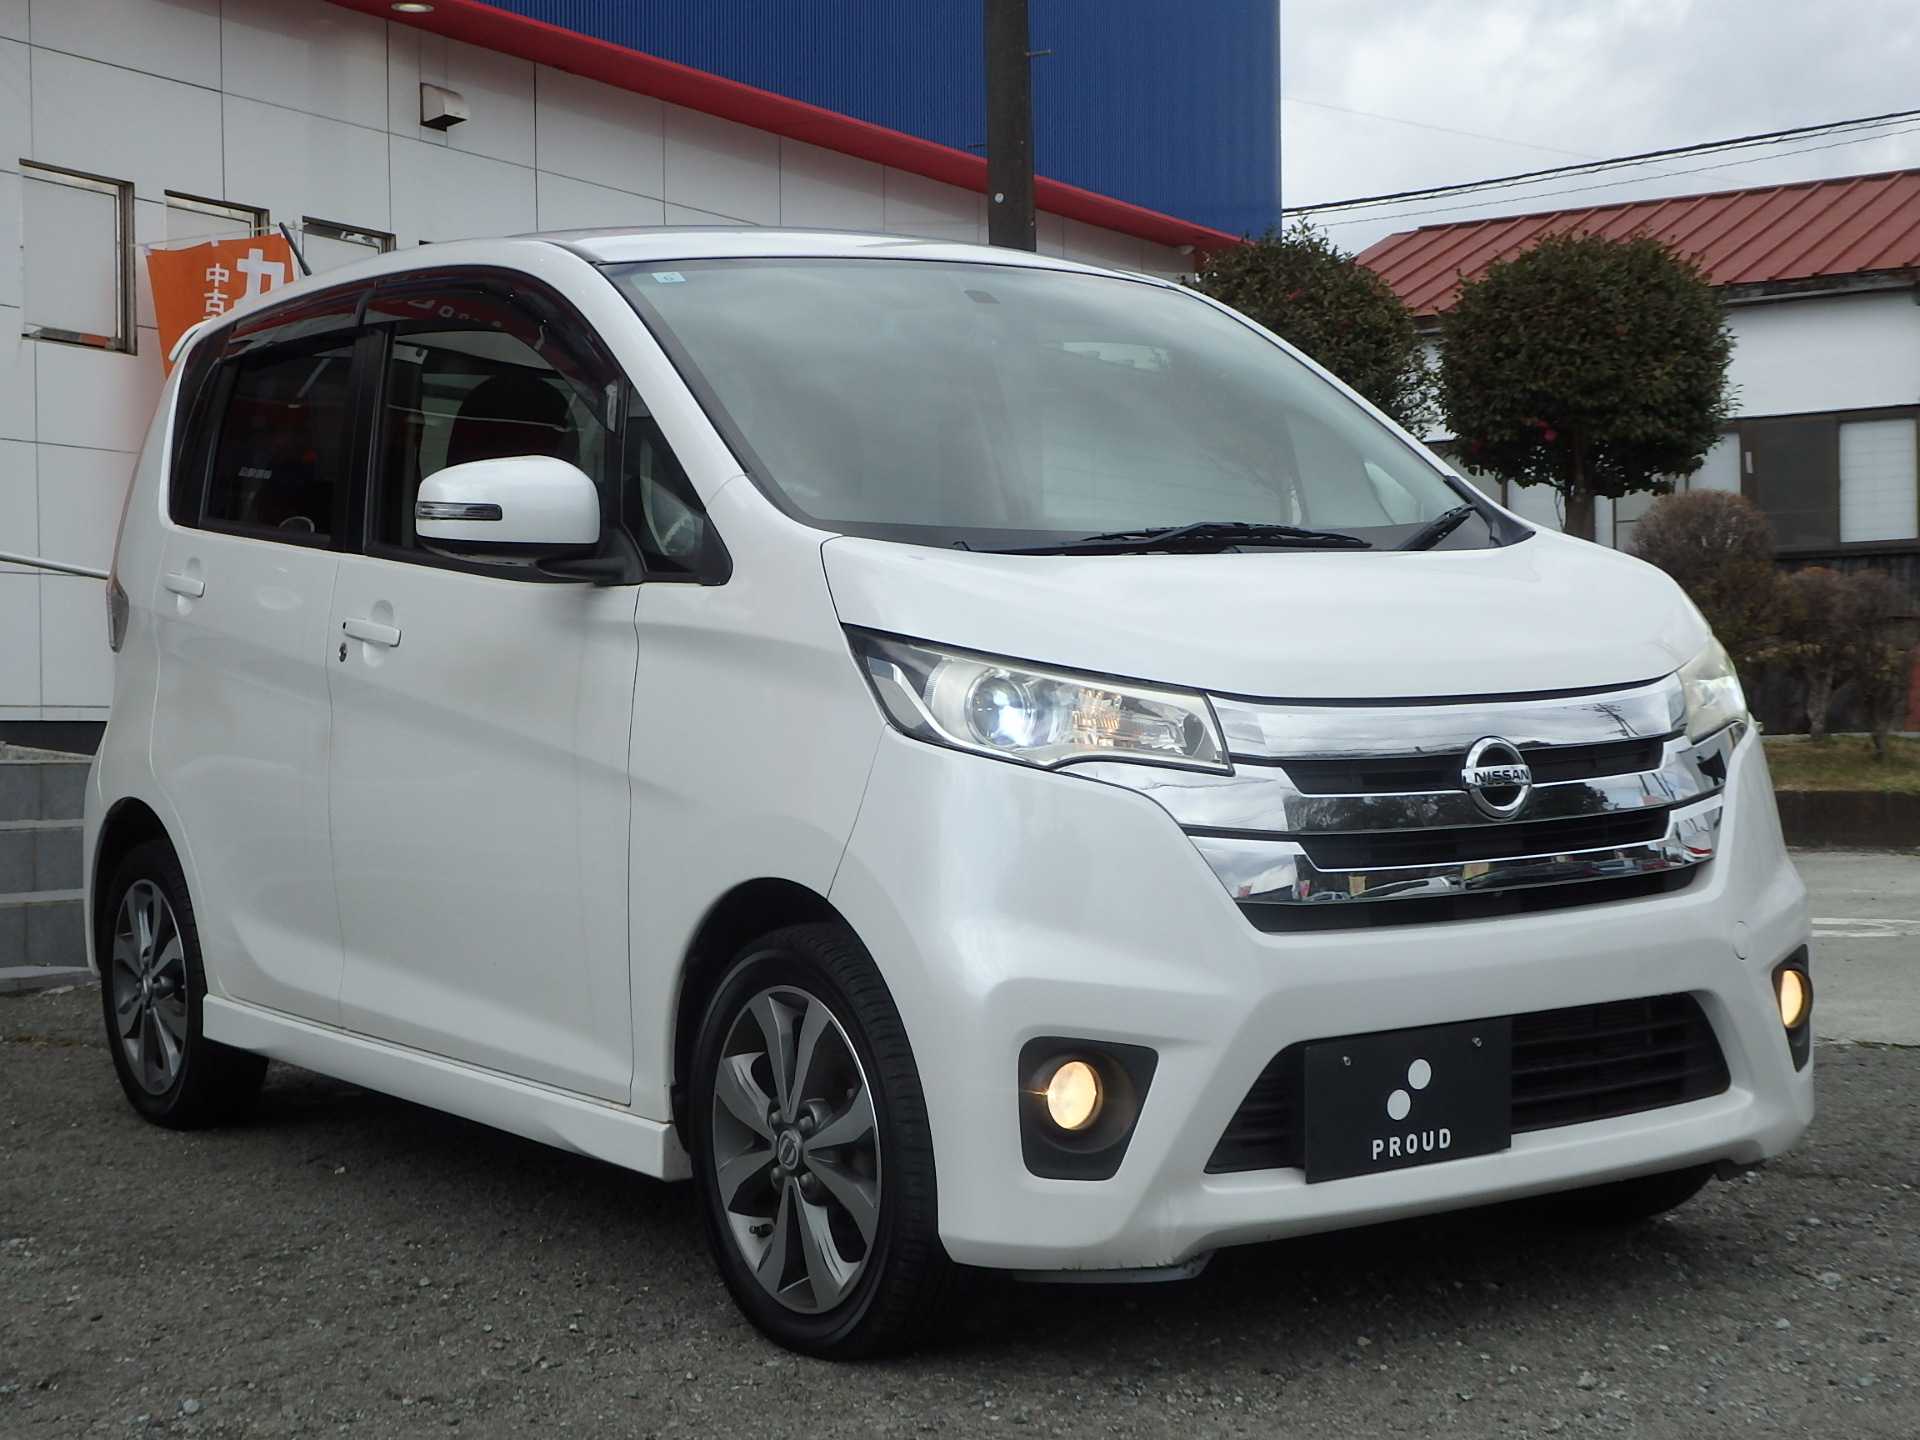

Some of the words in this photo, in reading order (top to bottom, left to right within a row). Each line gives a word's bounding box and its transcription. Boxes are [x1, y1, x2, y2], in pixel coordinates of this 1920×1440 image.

[203, 263, 230, 320] 中古
[1474, 769, 1529, 784] NISSAN
[1372, 1128, 1451, 1161] PROUD
